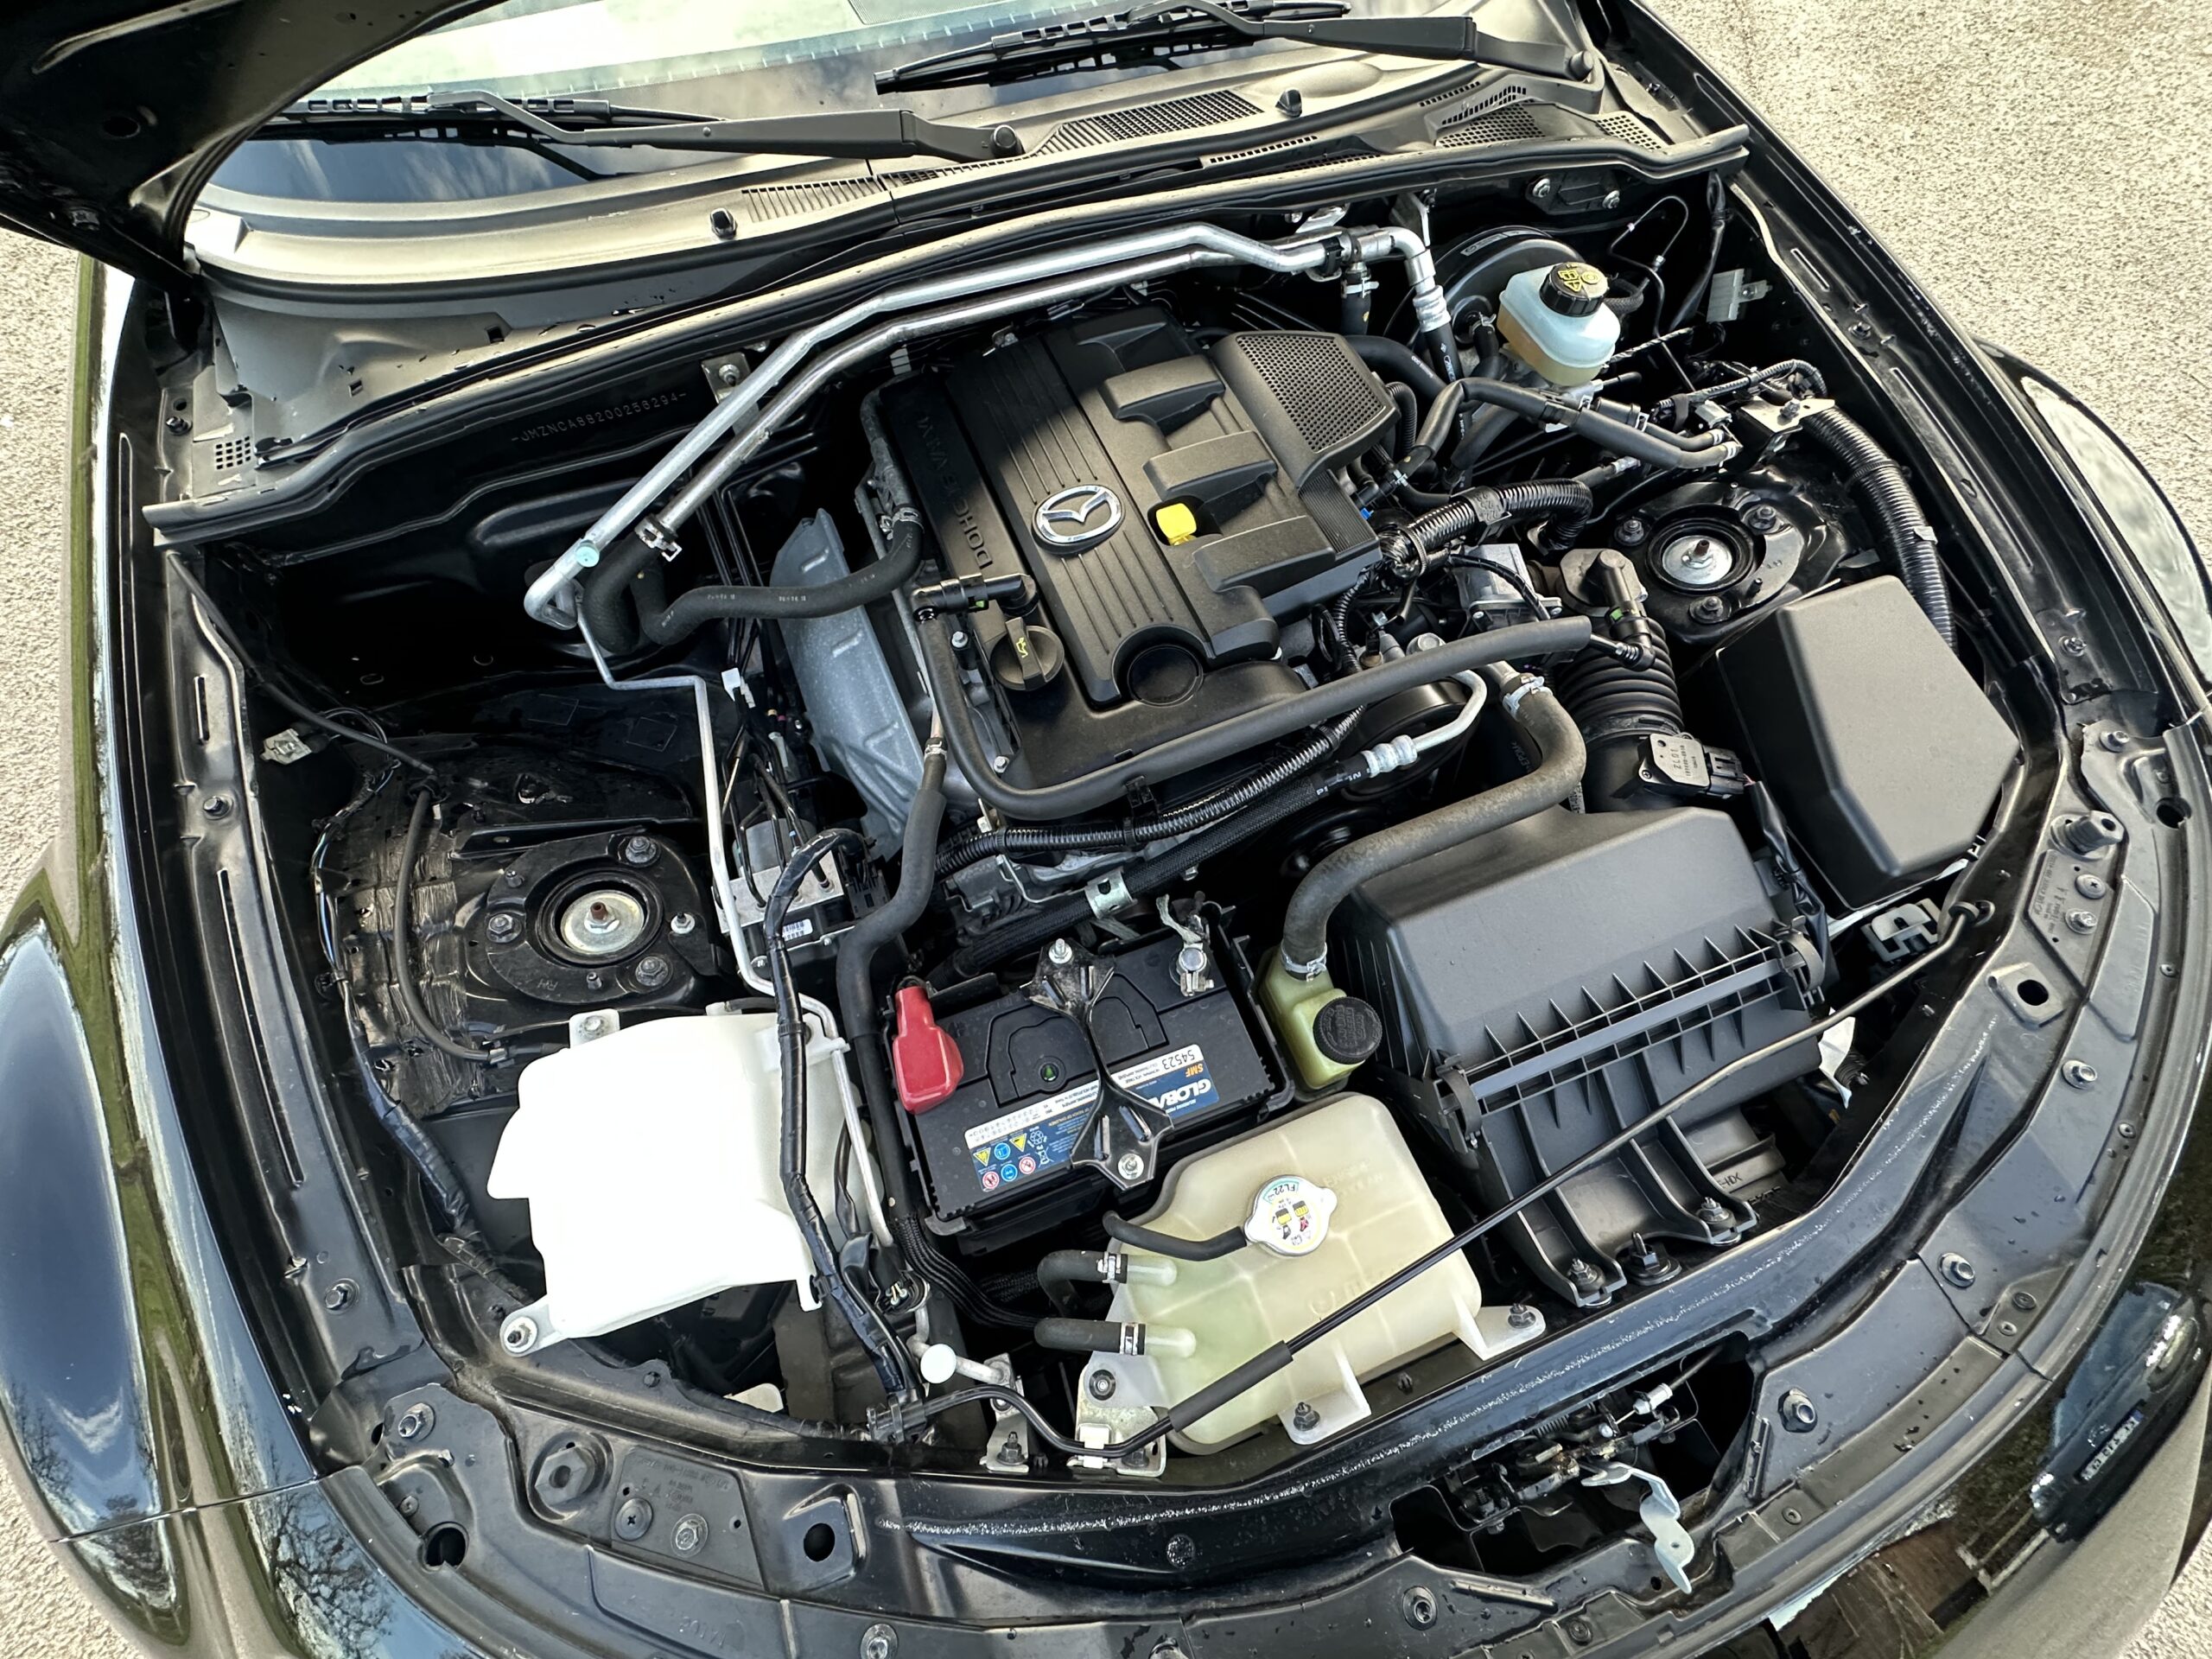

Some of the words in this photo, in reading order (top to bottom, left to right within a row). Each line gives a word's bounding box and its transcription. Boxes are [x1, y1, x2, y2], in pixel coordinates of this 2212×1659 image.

[954, 499, 993, 569] DOHC
[1162, 1049, 1196, 1071] 54523
[1185, 1063, 1204, 1077] SMF
[1273, 1184, 1295, 1196] FL22
